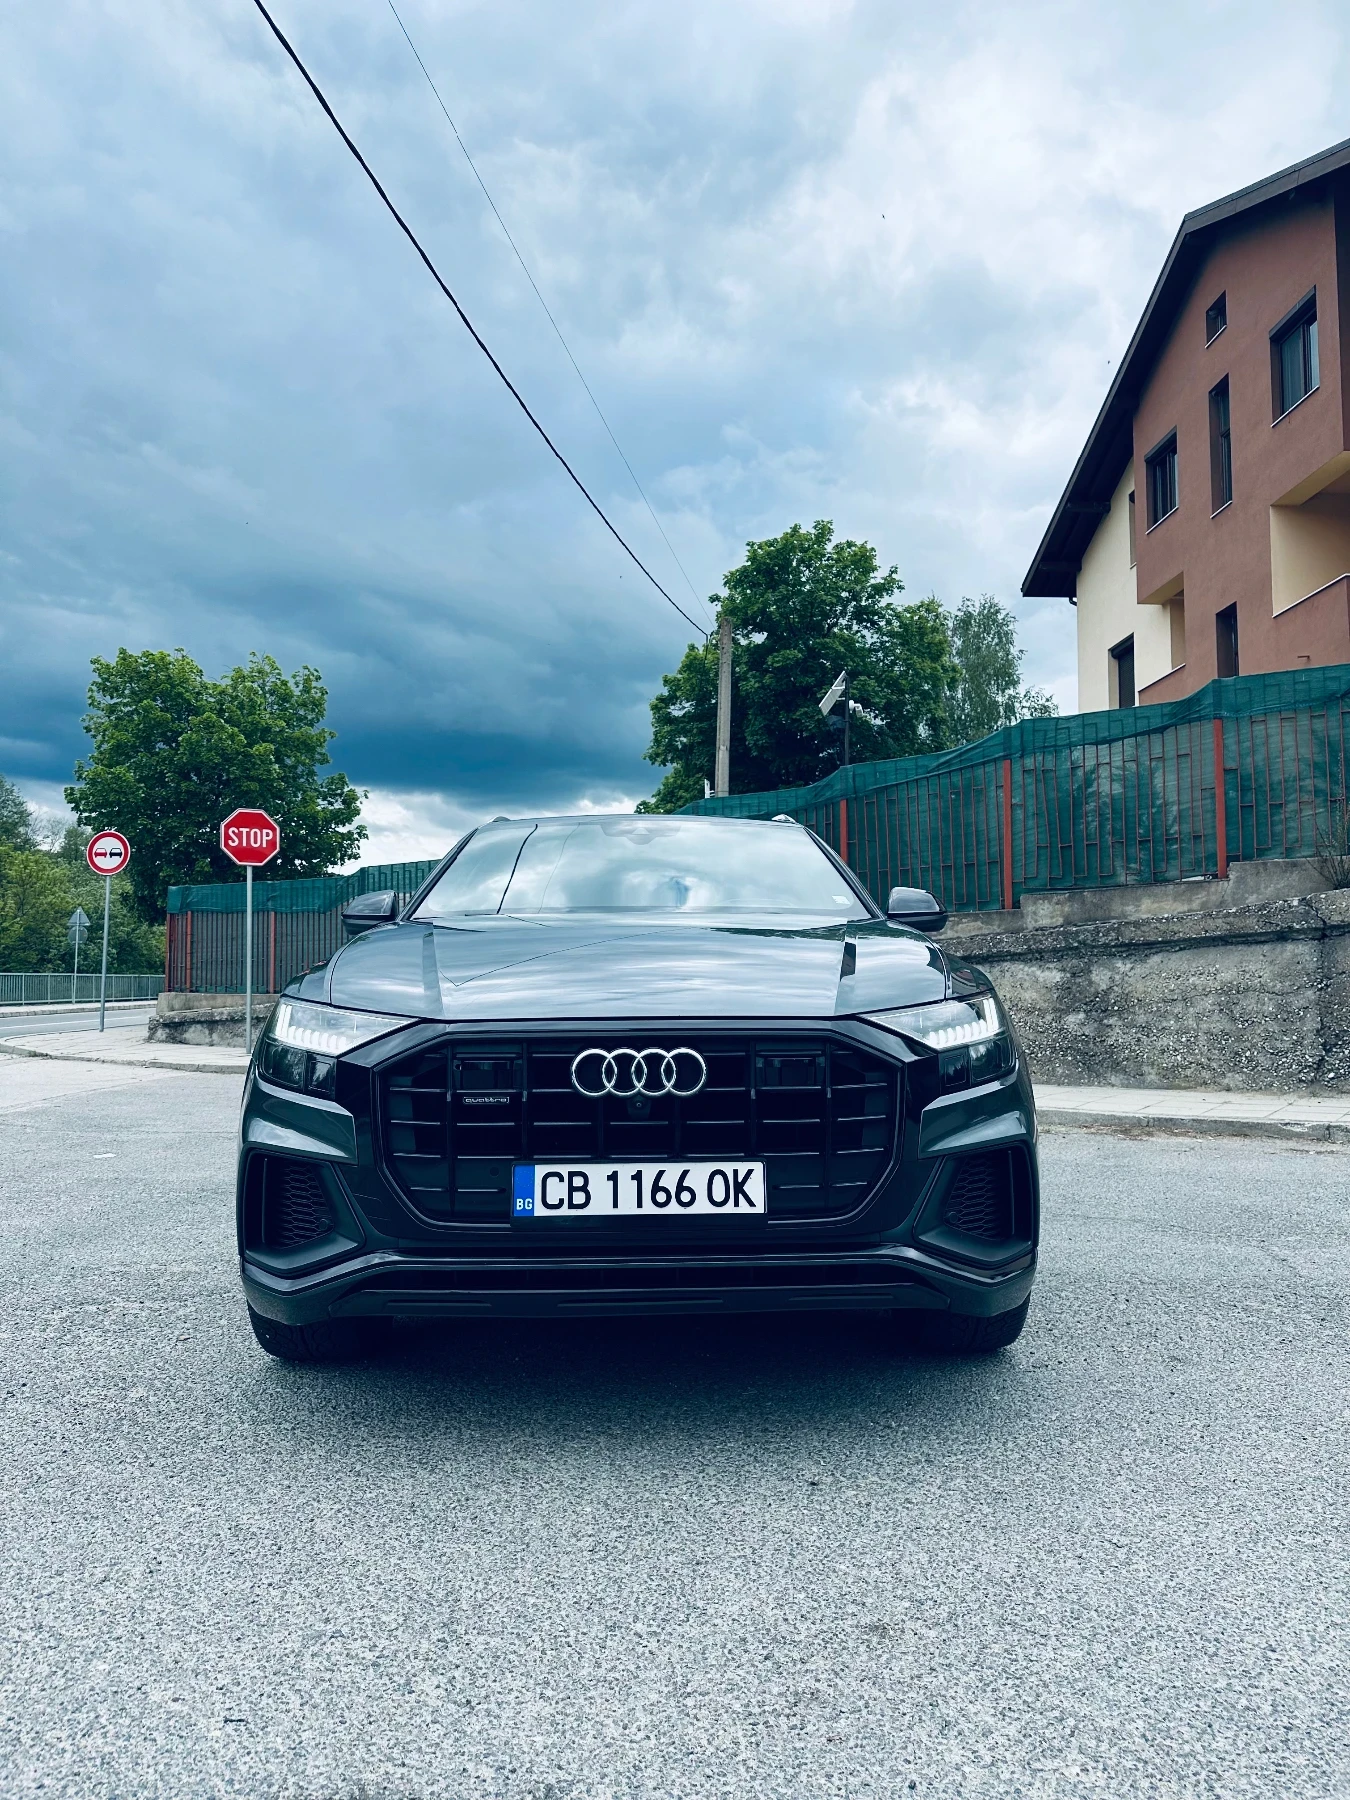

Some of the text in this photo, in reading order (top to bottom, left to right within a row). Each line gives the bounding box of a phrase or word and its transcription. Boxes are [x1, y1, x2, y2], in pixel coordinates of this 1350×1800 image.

[228, 827, 273, 848] STOP
[541, 1168, 756, 1210] CB 1166 OK
[516, 1198, 533, 1210] BG
